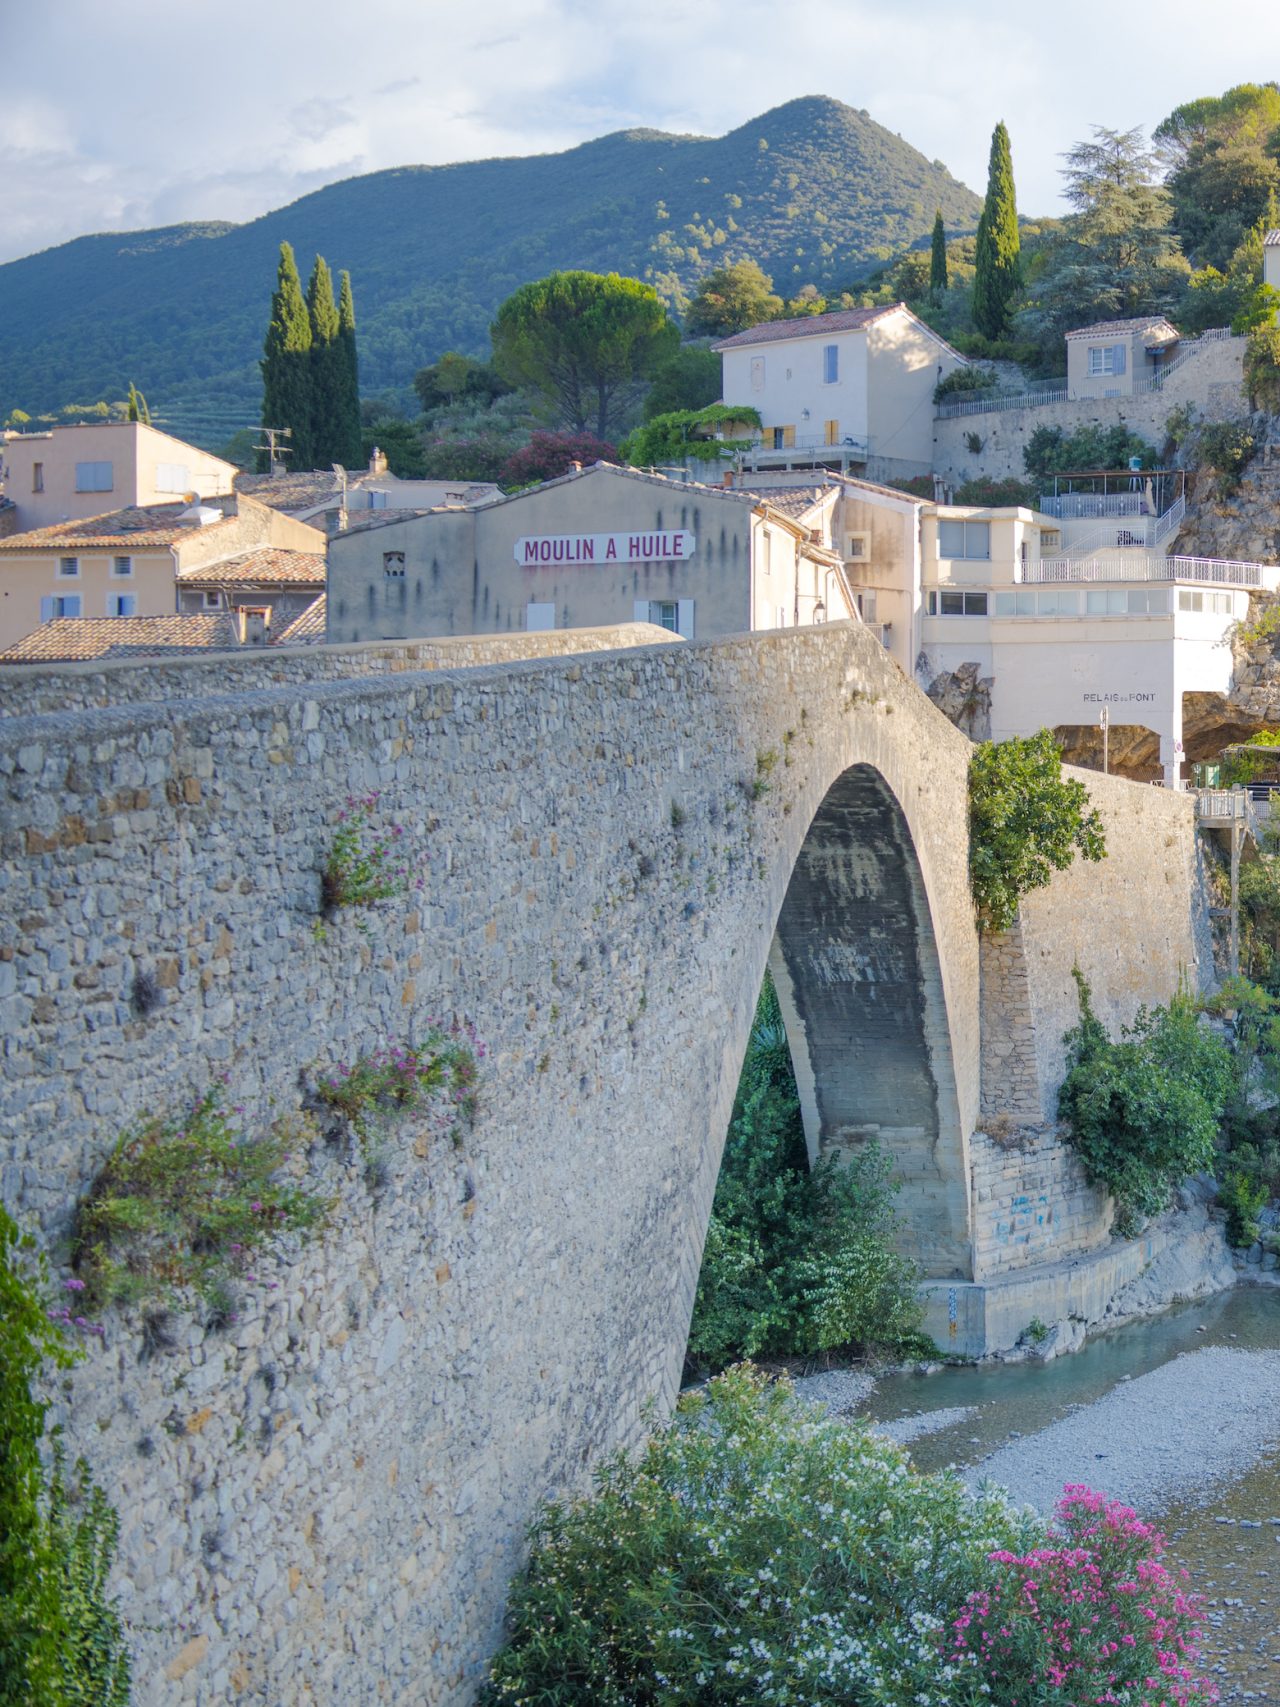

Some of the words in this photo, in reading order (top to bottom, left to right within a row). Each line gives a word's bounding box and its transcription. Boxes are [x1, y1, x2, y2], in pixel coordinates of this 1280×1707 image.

[525, 539, 594, 562] MOULIN
[606, 538, 617, 558] A
[629, 534, 684, 558] HUILE
[1083, 693, 1119, 702] RELAIS
[1129, 693, 1156, 702] PONT
